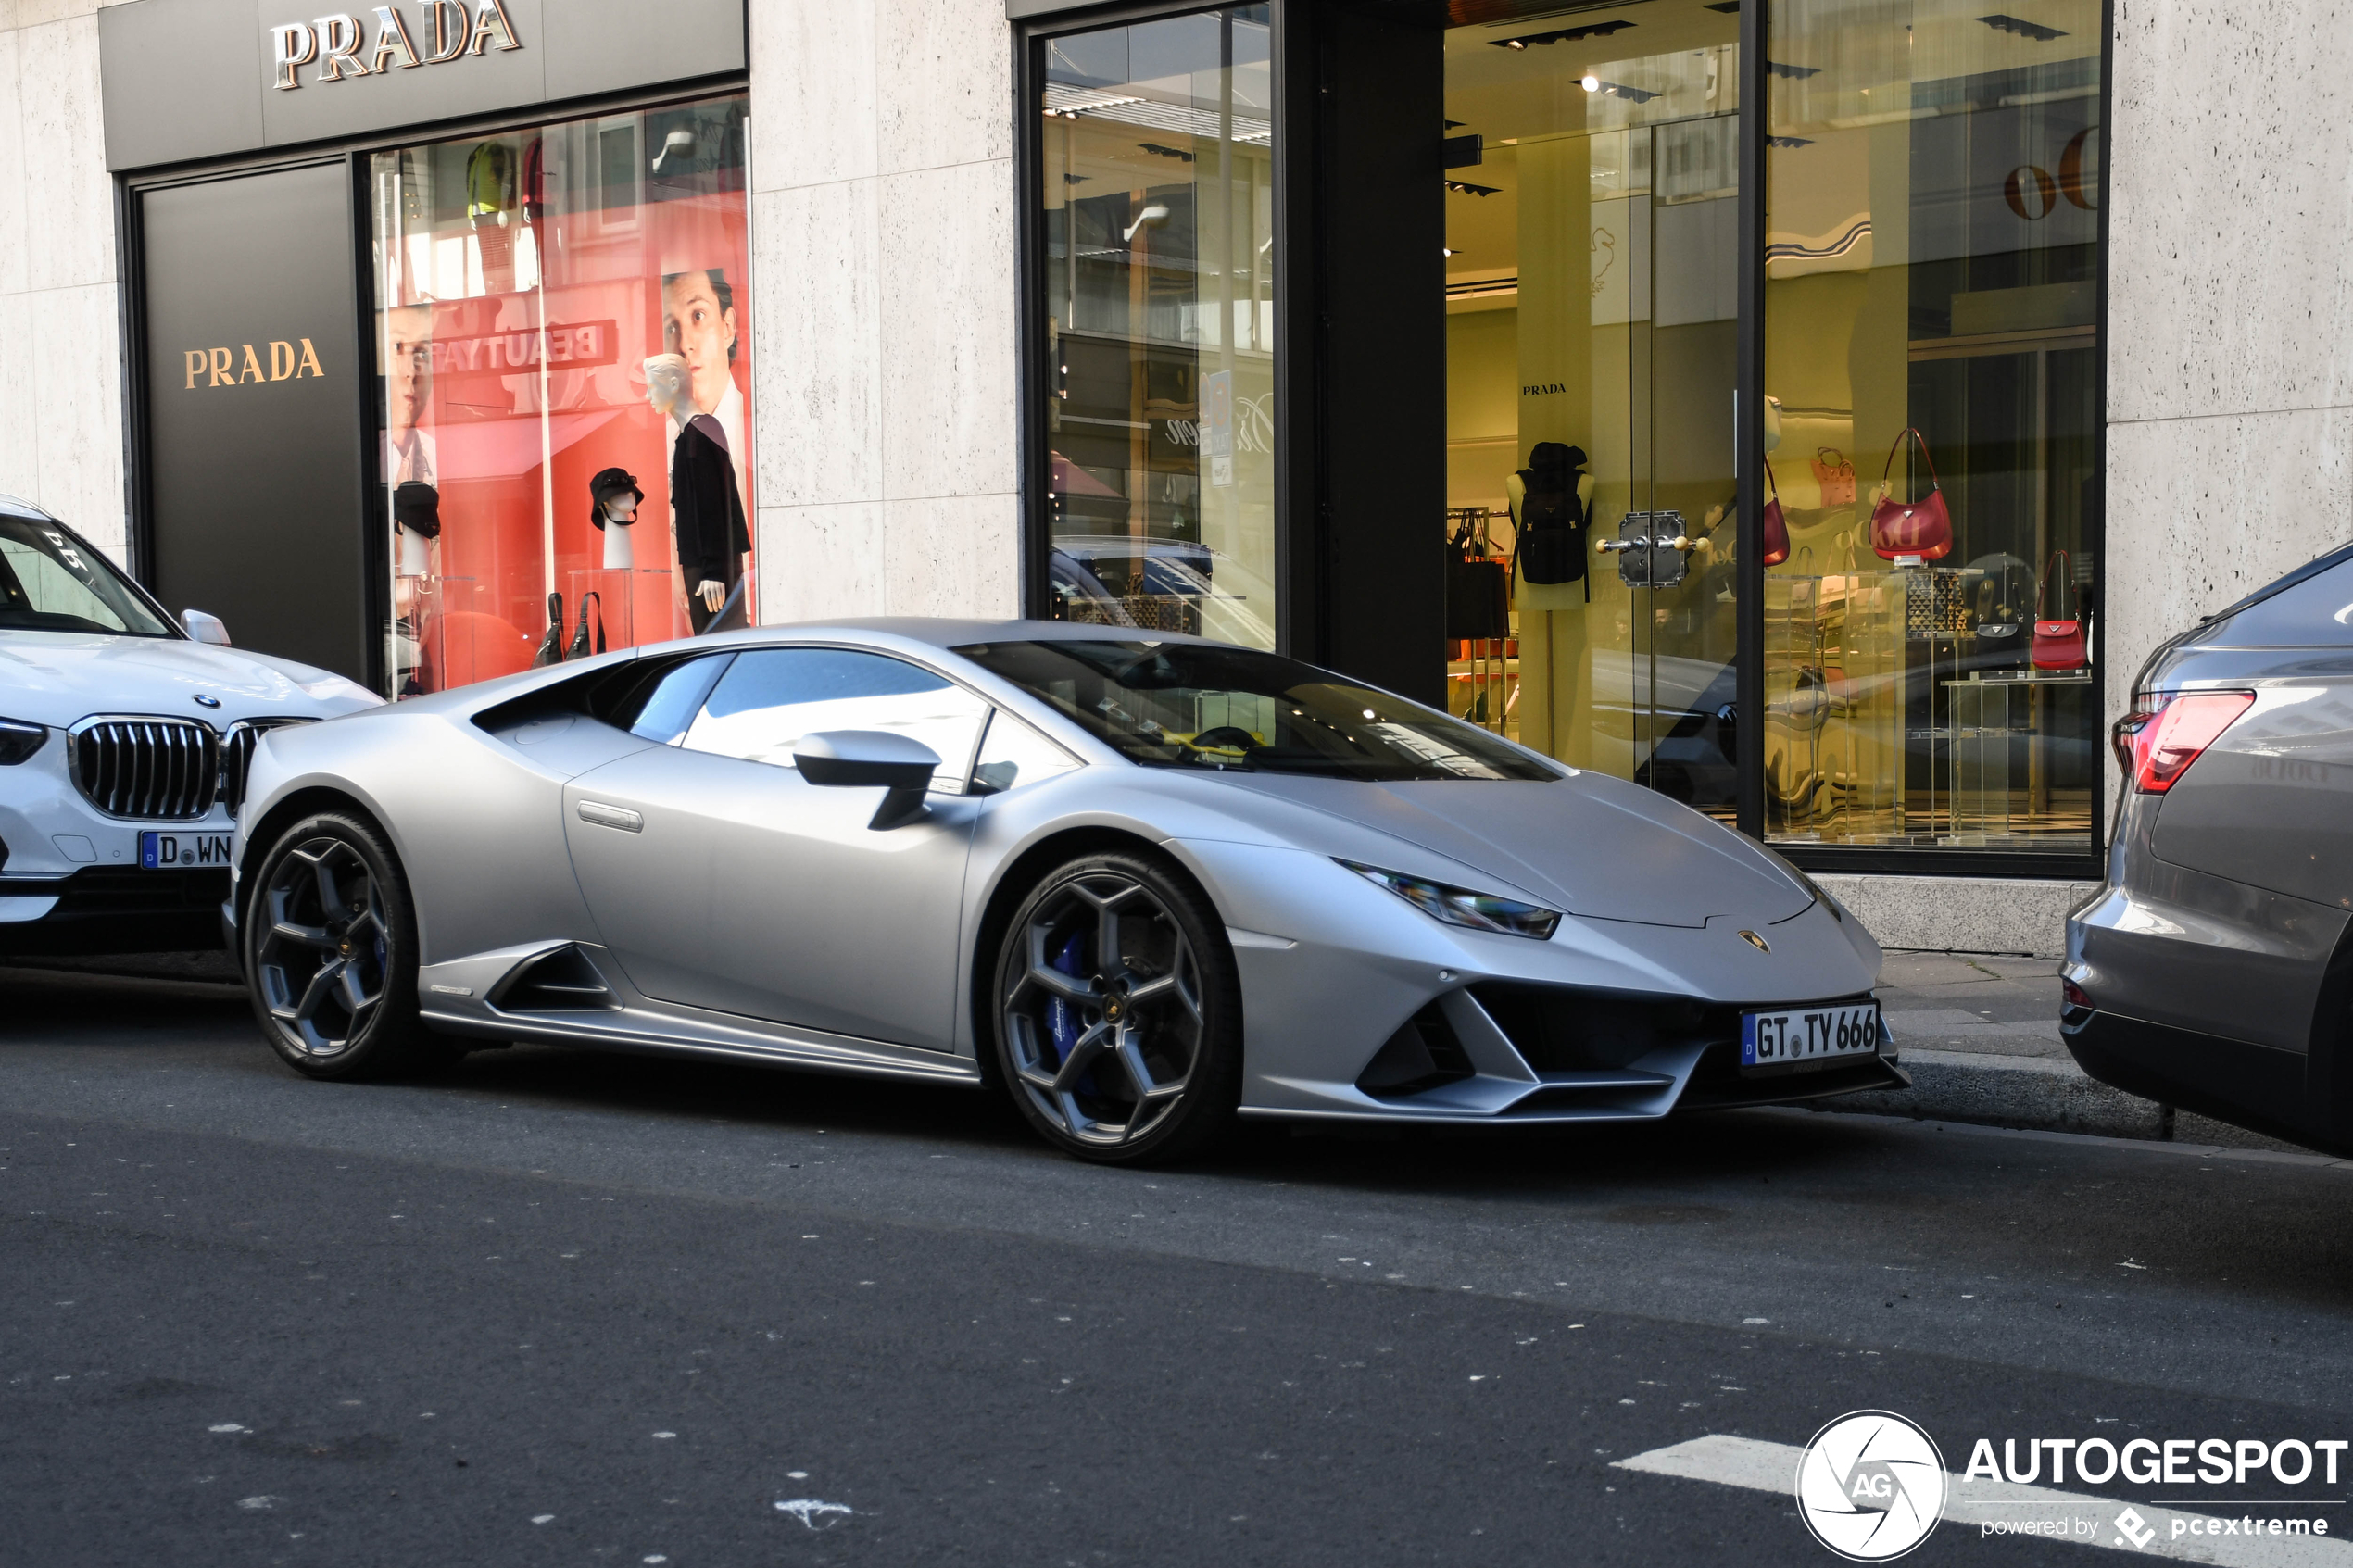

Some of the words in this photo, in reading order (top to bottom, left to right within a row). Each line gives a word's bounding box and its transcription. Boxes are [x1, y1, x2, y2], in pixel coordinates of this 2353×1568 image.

[270, 0, 520, 90] PRADA
[184, 338, 325, 389] PRADA
[1523, 383, 1566, 396] PRADA
[146, 854, 154, 862] D
[160, 836, 178, 863] D
[197, 836, 231, 863] WN
[1745, 1044, 1753, 1055] D
[1757, 1017, 1789, 1058] GT
